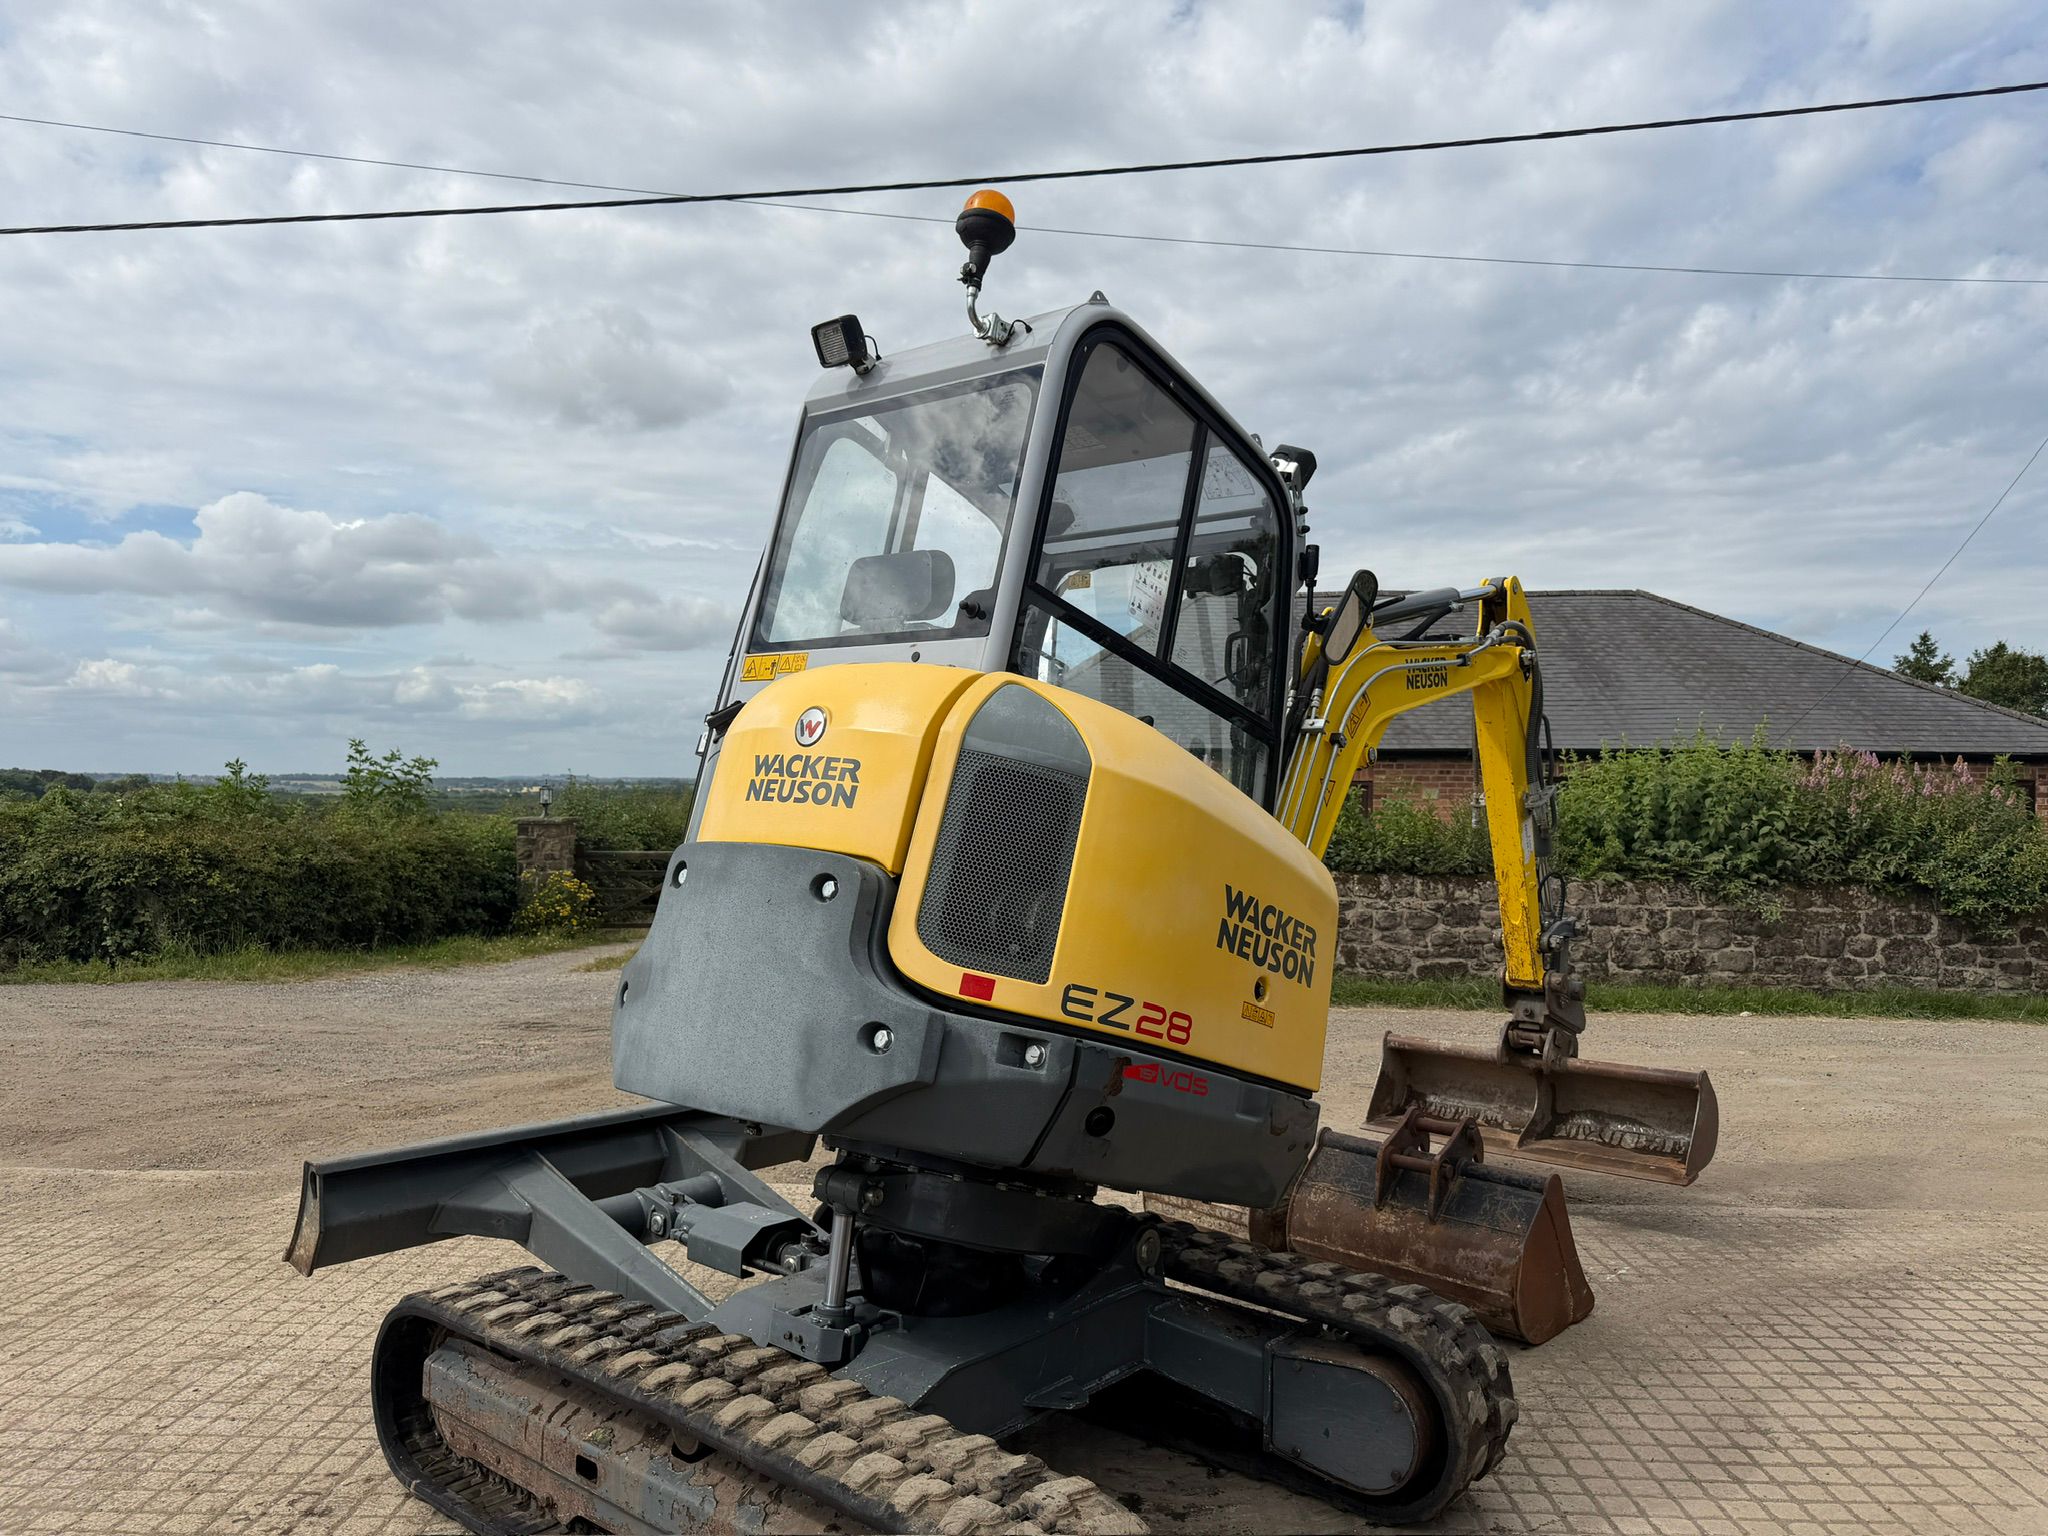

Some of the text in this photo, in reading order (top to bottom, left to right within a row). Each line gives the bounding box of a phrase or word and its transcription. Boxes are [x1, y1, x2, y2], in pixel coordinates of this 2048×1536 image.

[1406, 672, 1448, 690] NEUSON
[754, 754, 861, 783] WACKER
[745, 779, 859, 809] NEUSON
[1225, 883, 1317, 959] WACKER
[1216, 917, 1315, 989] NEUSON
[1061, 983, 1193, 1045] EZ28
